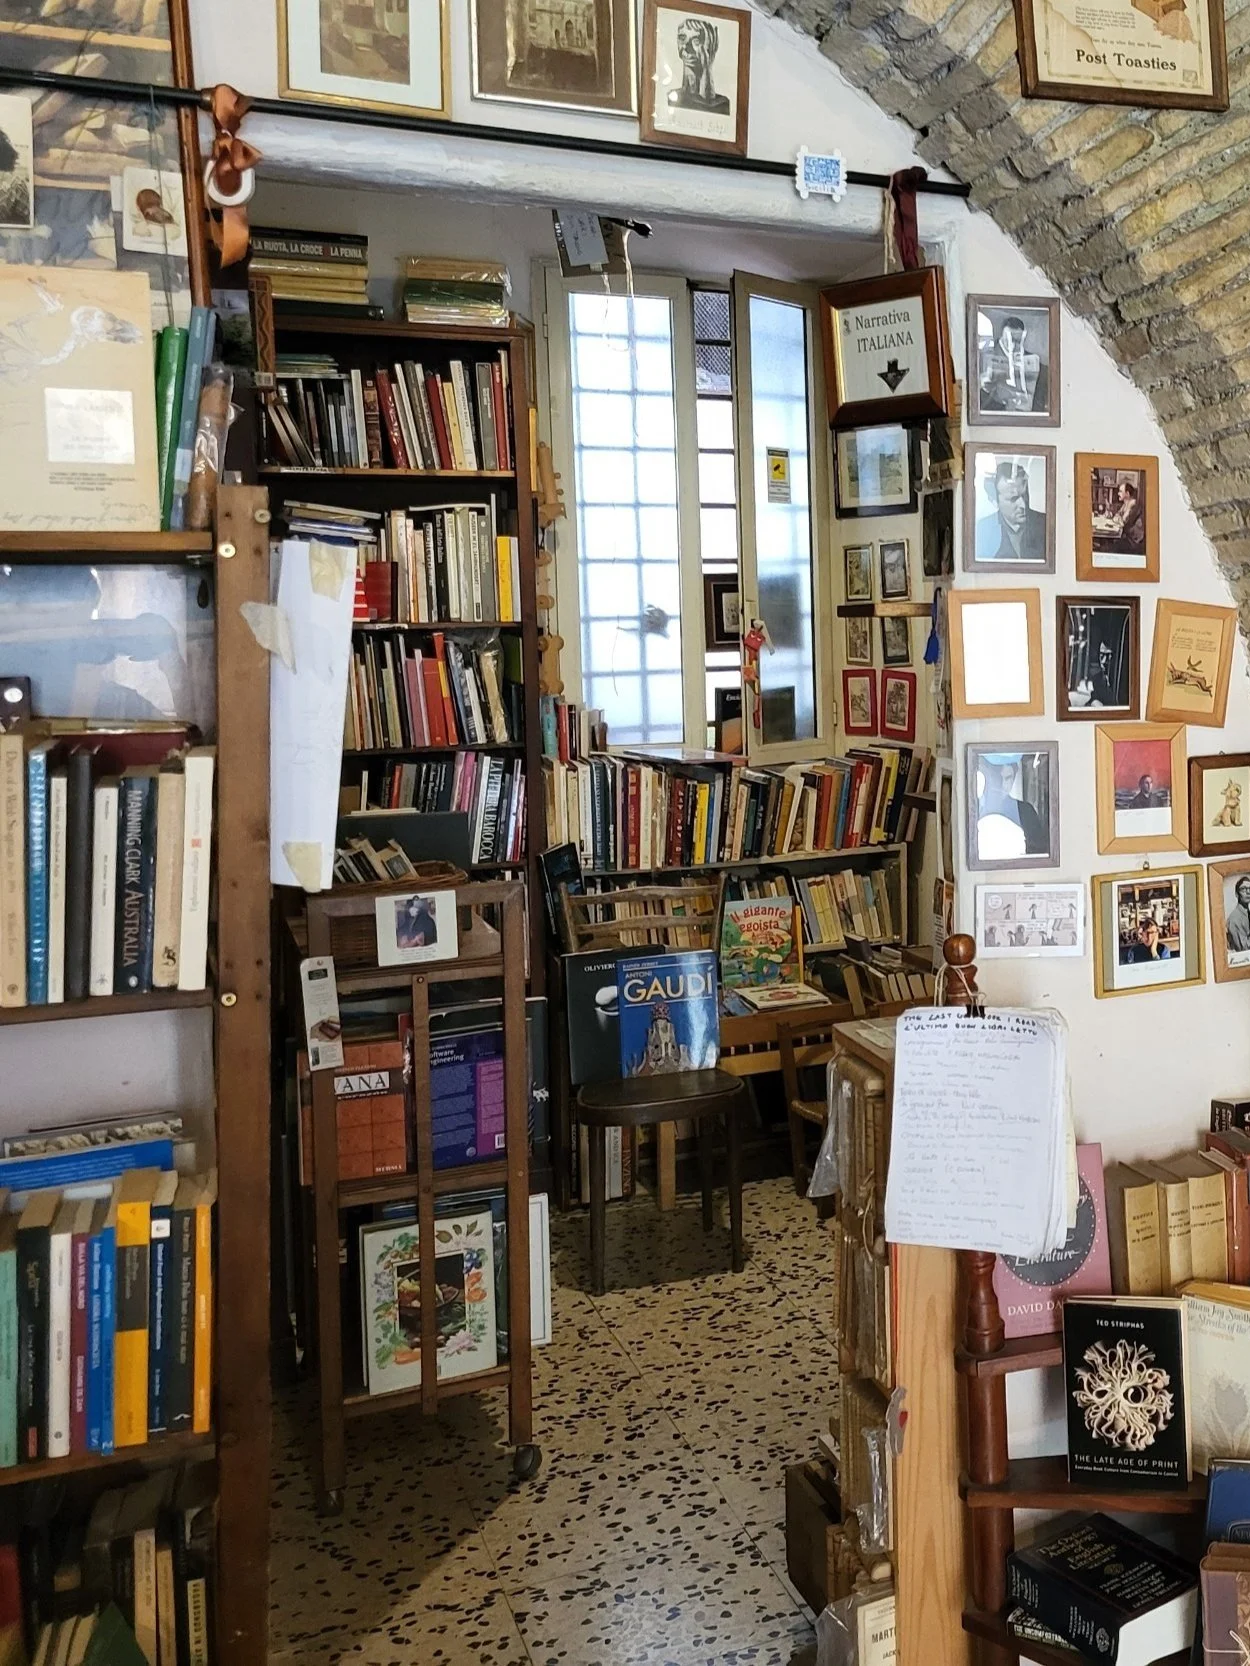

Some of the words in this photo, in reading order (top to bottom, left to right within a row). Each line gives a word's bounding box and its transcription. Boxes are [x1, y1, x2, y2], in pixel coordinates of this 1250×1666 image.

[1076, 49, 1107, 65] Post
[1113, 52, 1177, 71] Toasties
[253, 241, 263, 250] LA
[290, 244, 299, 253] LA
[300, 244, 323, 255] CROCE
[331, 247, 340, 256] LA
[340, 247, 362, 258] PENNA
[855, 310, 910, 331] Narrativa
[857, 330, 914, 353] ITALIANA
[127, 790, 143, 846] MANNING
[126, 848, 142, 884] CLARK
[743, 906, 787, 919] gigante
[123, 889, 139, 967] AUSTRALIA
[739, 920, 780, 932] egoista
[625, 971, 653, 979] ANTONI
[623, 965, 713, 1003] GAUDÍ
[929, 1013, 951, 1021] LAST
[1015, 1018, 1036, 1026] READ
[1007, 1302, 1042, 1317] DAVID
[1096, 1319, 1109, 1327] TED
[1111, 1320, 1145, 1329] STRIPHAS
[1074, 1454, 1090, 1463] THE
[1093, 1455, 1114, 1465] LATE
[1117, 1457, 1135, 1466] AGE
[1137, 1459, 1149, 1467] OF
[1152, 1460, 1179, 1469] PRINT
